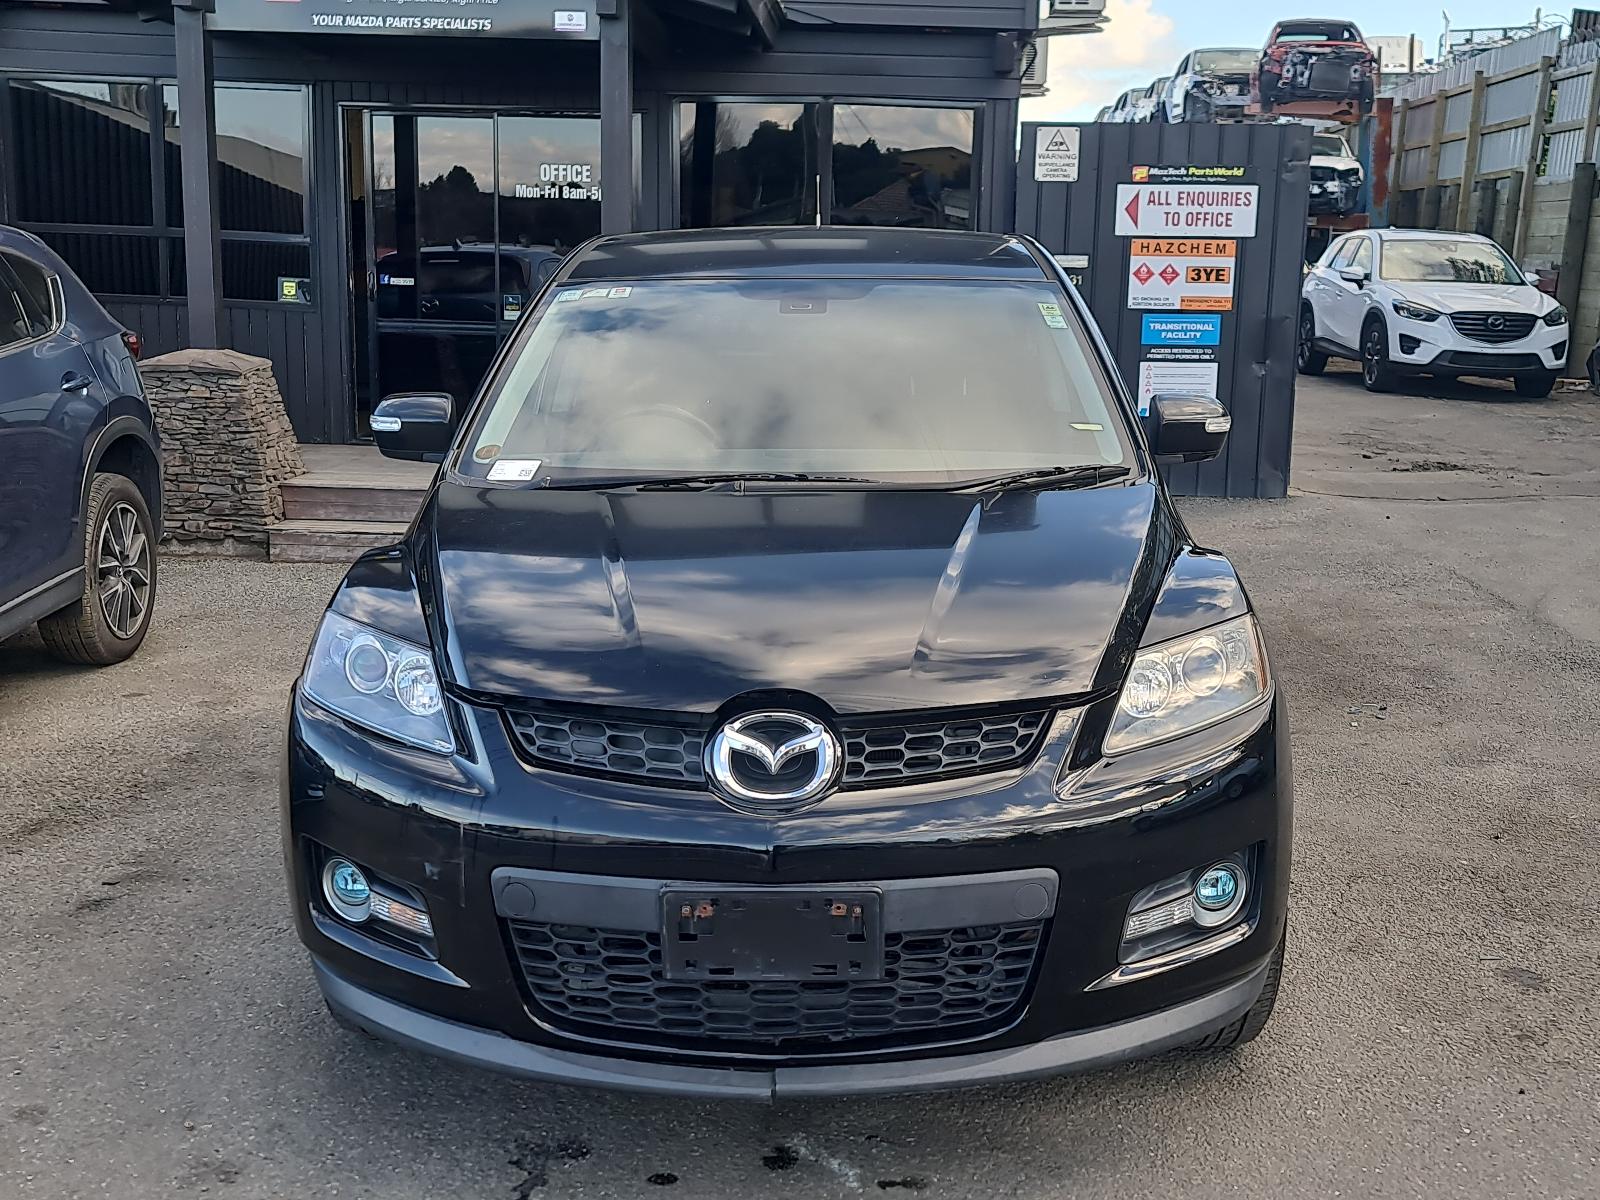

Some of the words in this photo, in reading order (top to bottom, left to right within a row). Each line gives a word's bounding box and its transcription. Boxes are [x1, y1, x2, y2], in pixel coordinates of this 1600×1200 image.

[312, 14, 344, 26] YOUR
[344, 15, 384, 27] MAZDA
[385, 16, 421, 29] PARTS
[422, 17, 492, 31] SPECIALISTS
[540, 164, 592, 182] OFFICE
[1149, 167, 1188, 176] MazTech
[1188, 167, 1245, 176] PartsWorld
[515, 184, 559, 199] Mon-Fri
[1147, 190, 1172, 206] ALL
[1177, 191, 1253, 208] ENQUIRIES
[1164, 211, 1181, 227] TO
[1185, 211, 1233, 228] OFFICE
[1140, 242, 1227, 255] HAZCHEM
[1190, 268, 1226, 281] 3YE
[1149, 323, 1215, 331] TRANSITIONAL
[1161, 331, 1202, 339] FACILITY
